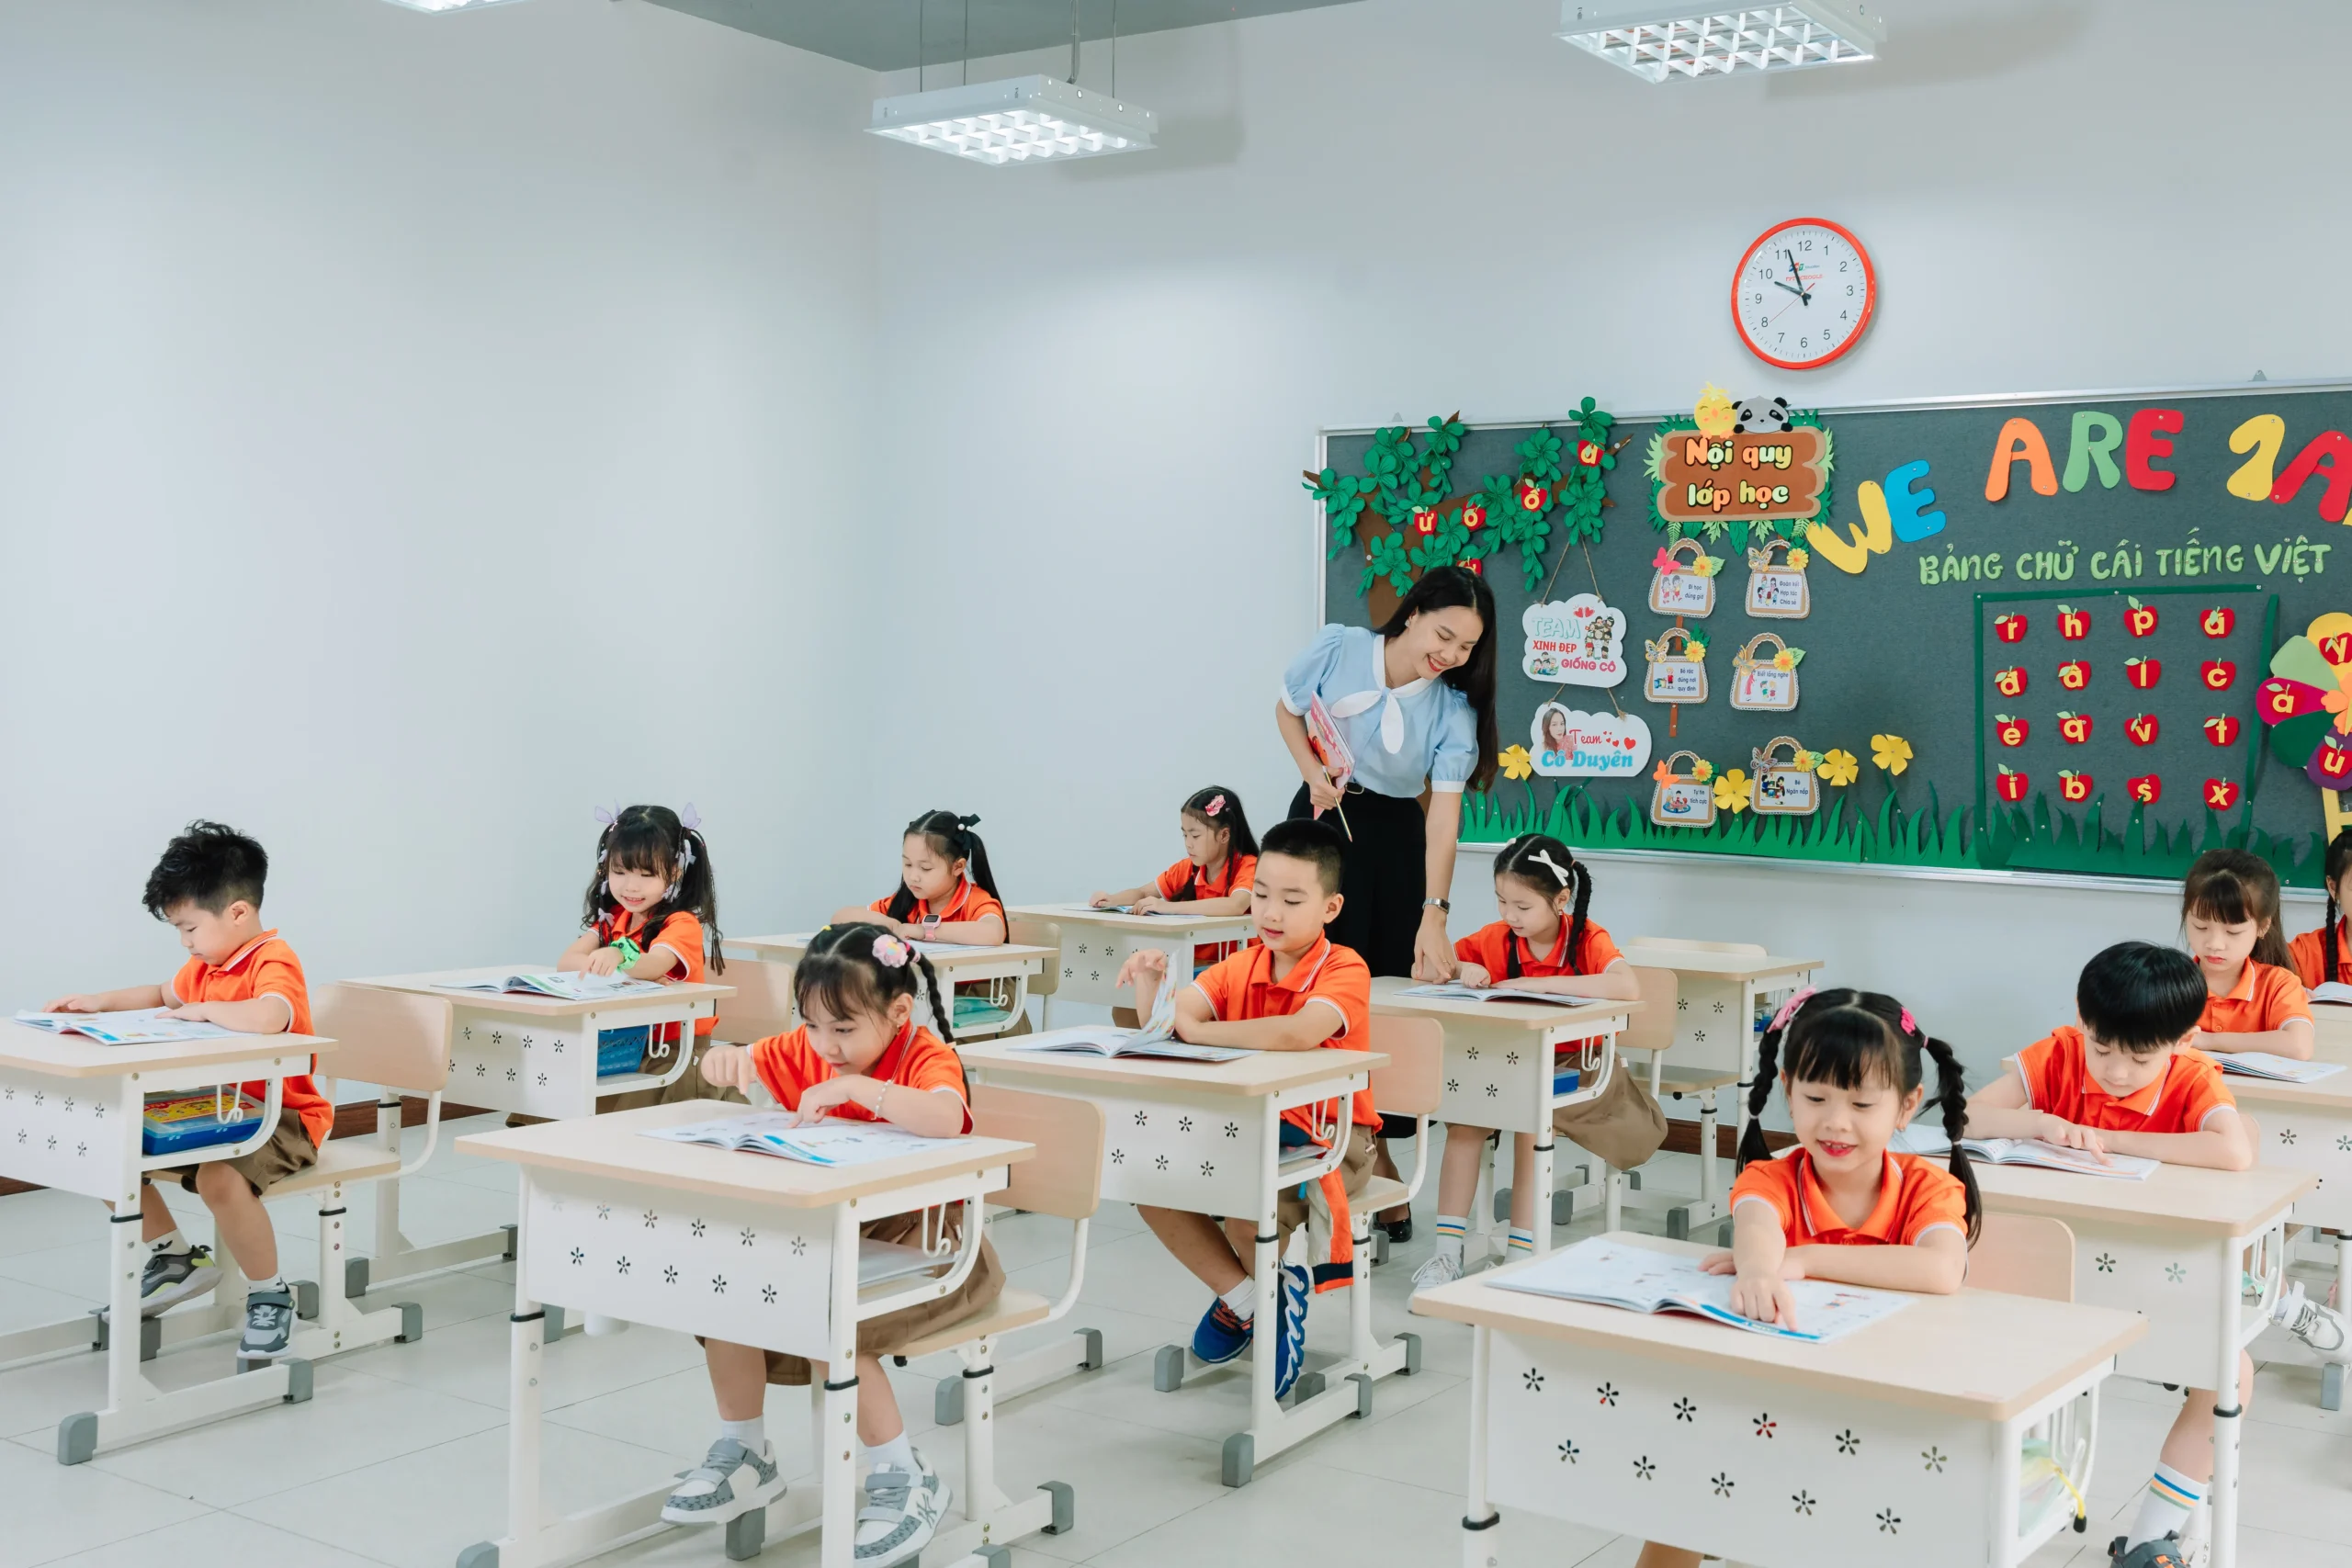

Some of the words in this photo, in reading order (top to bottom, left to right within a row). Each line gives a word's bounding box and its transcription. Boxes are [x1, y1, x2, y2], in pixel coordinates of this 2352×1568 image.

[1798, 241, 1812, 252] 12
[1824, 244, 1828, 255] 1
[1775, 250, 1788, 260] 11
[1758, 268, 1773, 279] 10
[1839, 261, 1847, 272] 2
[1847, 286, 1854, 296] 3
[1755, 294, 1762, 304] 9
[1761, 317, 1768, 327] 8
[1840, 310, 1847, 321] 4
[1778, 333, 1785, 343] 7
[1801, 337, 1808, 348] 6
[1824, 330, 1830, 340] 5
[1685, 437, 1734, 470] Nội
[1742, 445, 1792, 469] quy
[1524, 489, 1540, 509] ô
[1687, 479, 1731, 513] lớp
[1739, 479, 1789, 510] học
[1806, 459, 1946, 574] WE
[1984, 409, 2185, 502] ARE
[1918, 543, 2003, 585] BẢNG
[2016, 539, 2079, 581] CHỮ
[2155, 526, 2245, 577] TIẾNG
[2254, 535, 2332, 584] VIỆT
[1532, 617, 1580, 639] TEAM
[2007, 622, 2018, 639] r
[2064, 614, 2082, 637] h
[2133, 611, 2154, 636] p
[1533, 640, 1556, 651] XINH
[1559, 643, 1577, 654] ĐẸP
[2330, 637, 2347, 663] y
[1561, 657, 1597, 671] GIỐNG
[1600, 660, 1616, 672] CÔ
[2207, 668, 2227, 687] c
[2272, 694, 2294, 714] a
[1569, 729, 1602, 744] Team
[2003, 728, 2021, 746] e
[2064, 719, 2085, 742] q
[2134, 724, 2152, 742] v
[2216, 719, 2227, 743] t
[1542, 750, 1566, 767] Cô
[1572, 750, 1634, 772] Duyên
[2324, 752, 2346, 774] u
[2008, 777, 2018, 799] i
[2065, 776, 2086, 799] b
[2137, 783, 2153, 802] s
[2209, 785, 2230, 807] x
